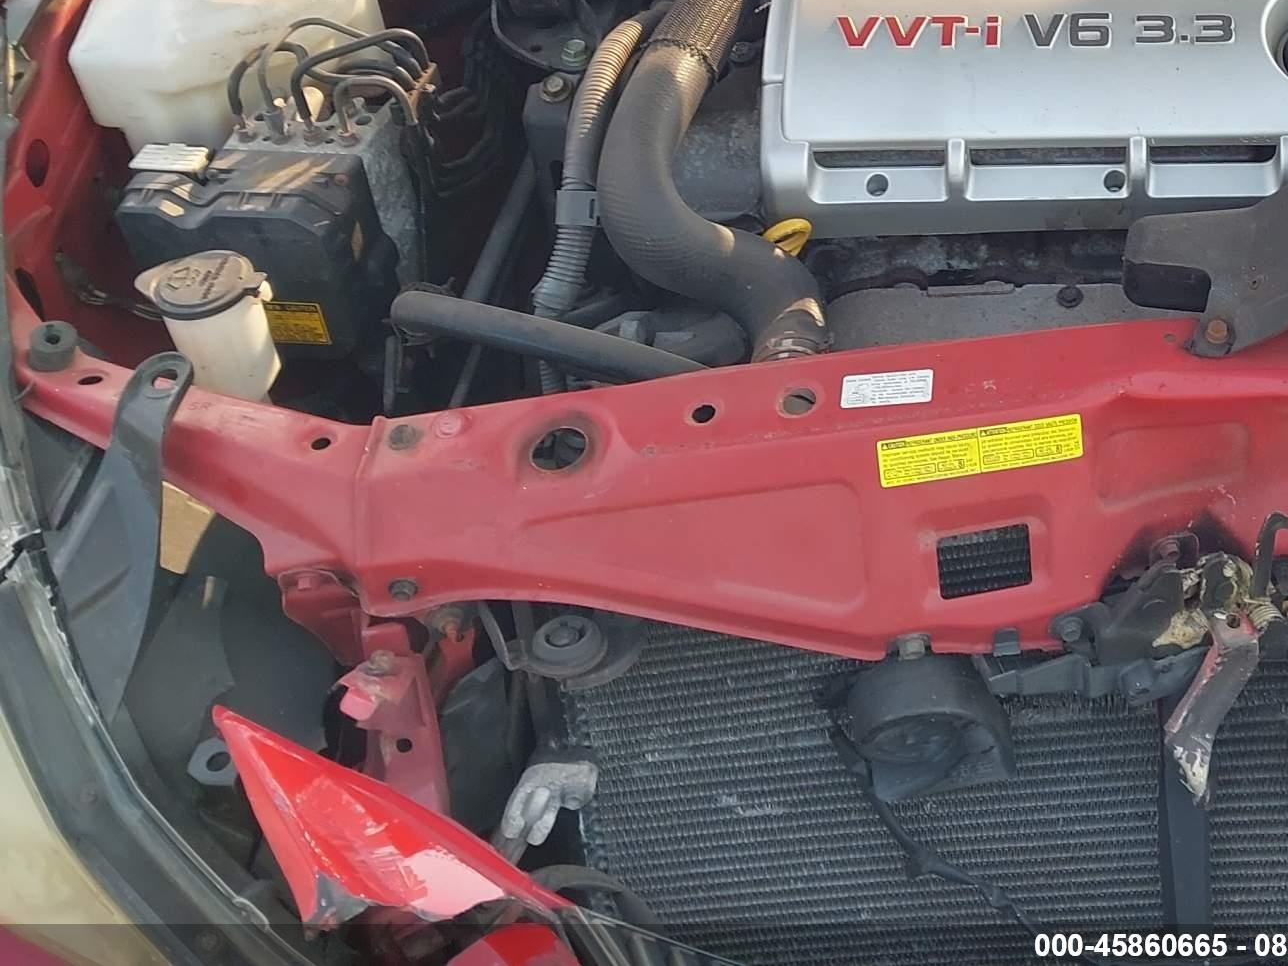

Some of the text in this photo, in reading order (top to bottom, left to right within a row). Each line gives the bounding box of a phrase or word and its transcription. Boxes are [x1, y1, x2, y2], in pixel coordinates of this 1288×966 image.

[836, 13, 1236, 49] VVT-i V6 3.3
